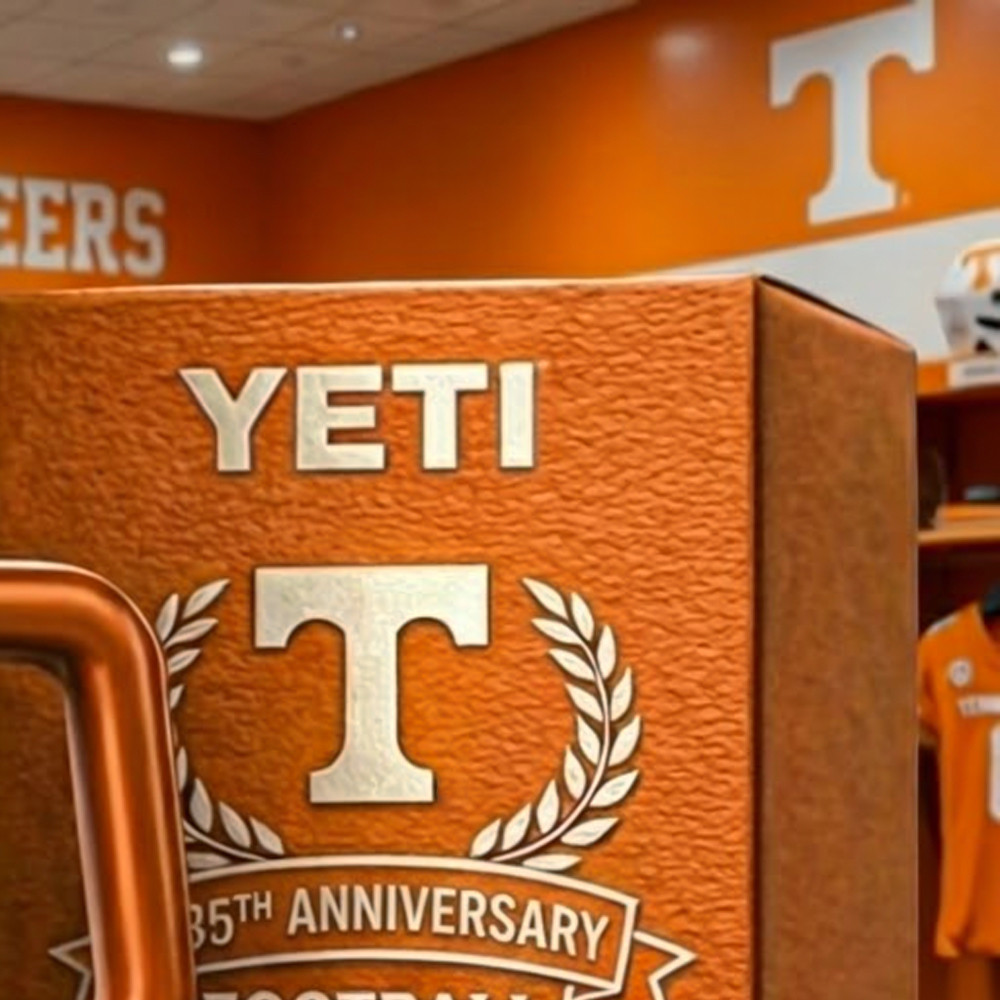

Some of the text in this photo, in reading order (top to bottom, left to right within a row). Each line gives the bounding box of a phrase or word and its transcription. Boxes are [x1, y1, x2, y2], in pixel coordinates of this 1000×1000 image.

[769, 0, 935, 226] T
[178, 360, 538, 472] YETI
[255, 564, 490, 803] T
[287, 884, 609, 962] ANNIVERSARY
